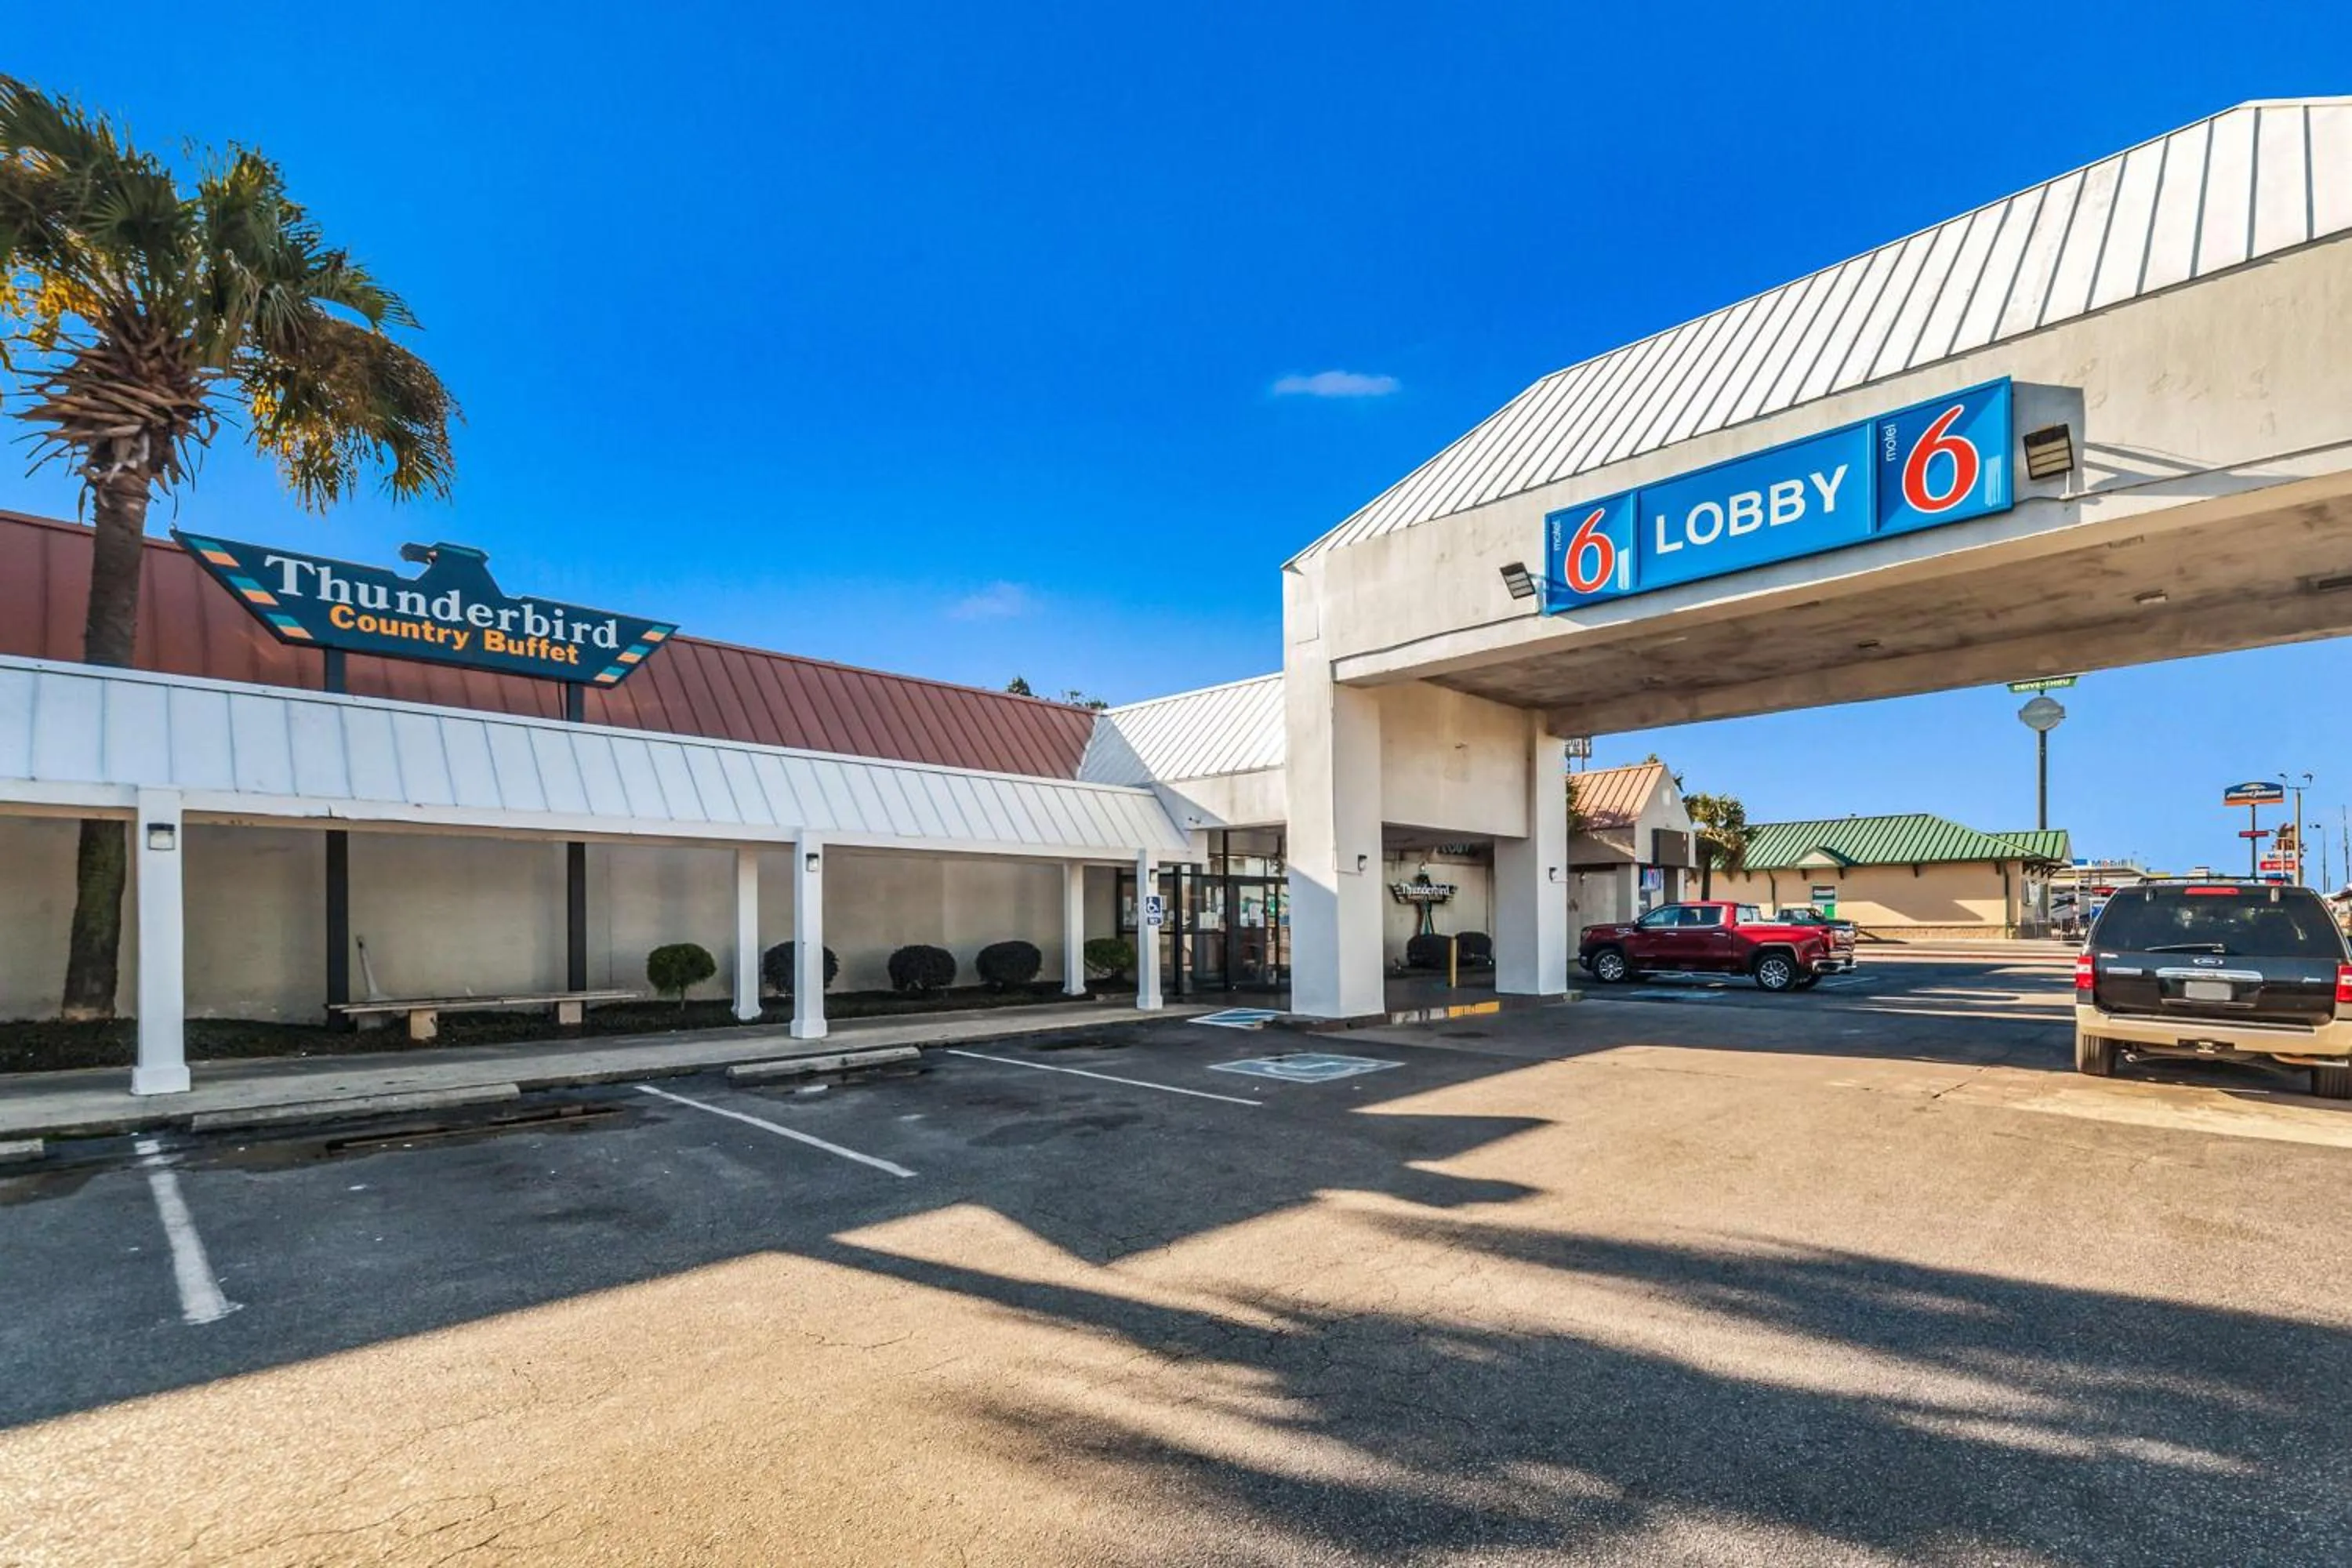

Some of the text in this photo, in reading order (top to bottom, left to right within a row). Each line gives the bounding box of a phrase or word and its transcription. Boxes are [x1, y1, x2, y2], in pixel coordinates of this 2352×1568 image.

[1883, 404, 1980, 514] motel 6
[1564, 507, 1615, 594] 6
[1656, 464, 1849, 555] LOBBY
[264, 554, 619, 650] Thunderbird
[329, 604, 579, 666] Country Buffet
